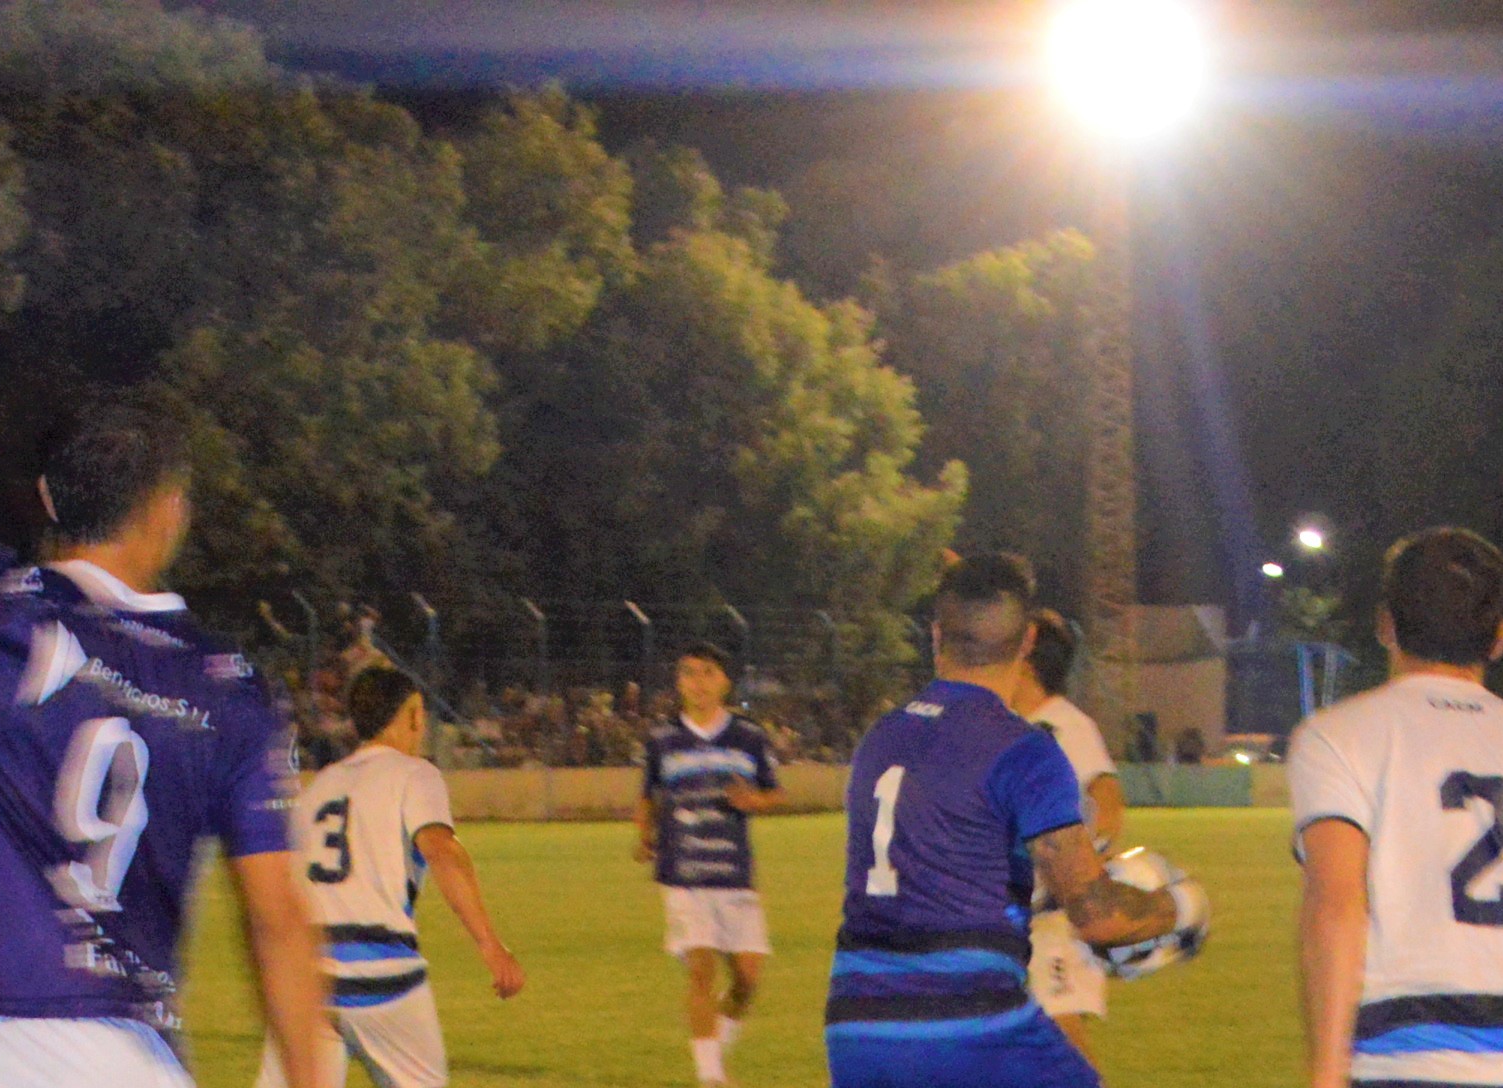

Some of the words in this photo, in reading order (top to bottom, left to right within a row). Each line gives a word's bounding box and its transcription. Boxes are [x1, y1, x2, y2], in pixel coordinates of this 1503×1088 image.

[48, 717, 149, 912] 9
[307, 796, 350, 884] 3
[865, 765, 905, 897] 1
